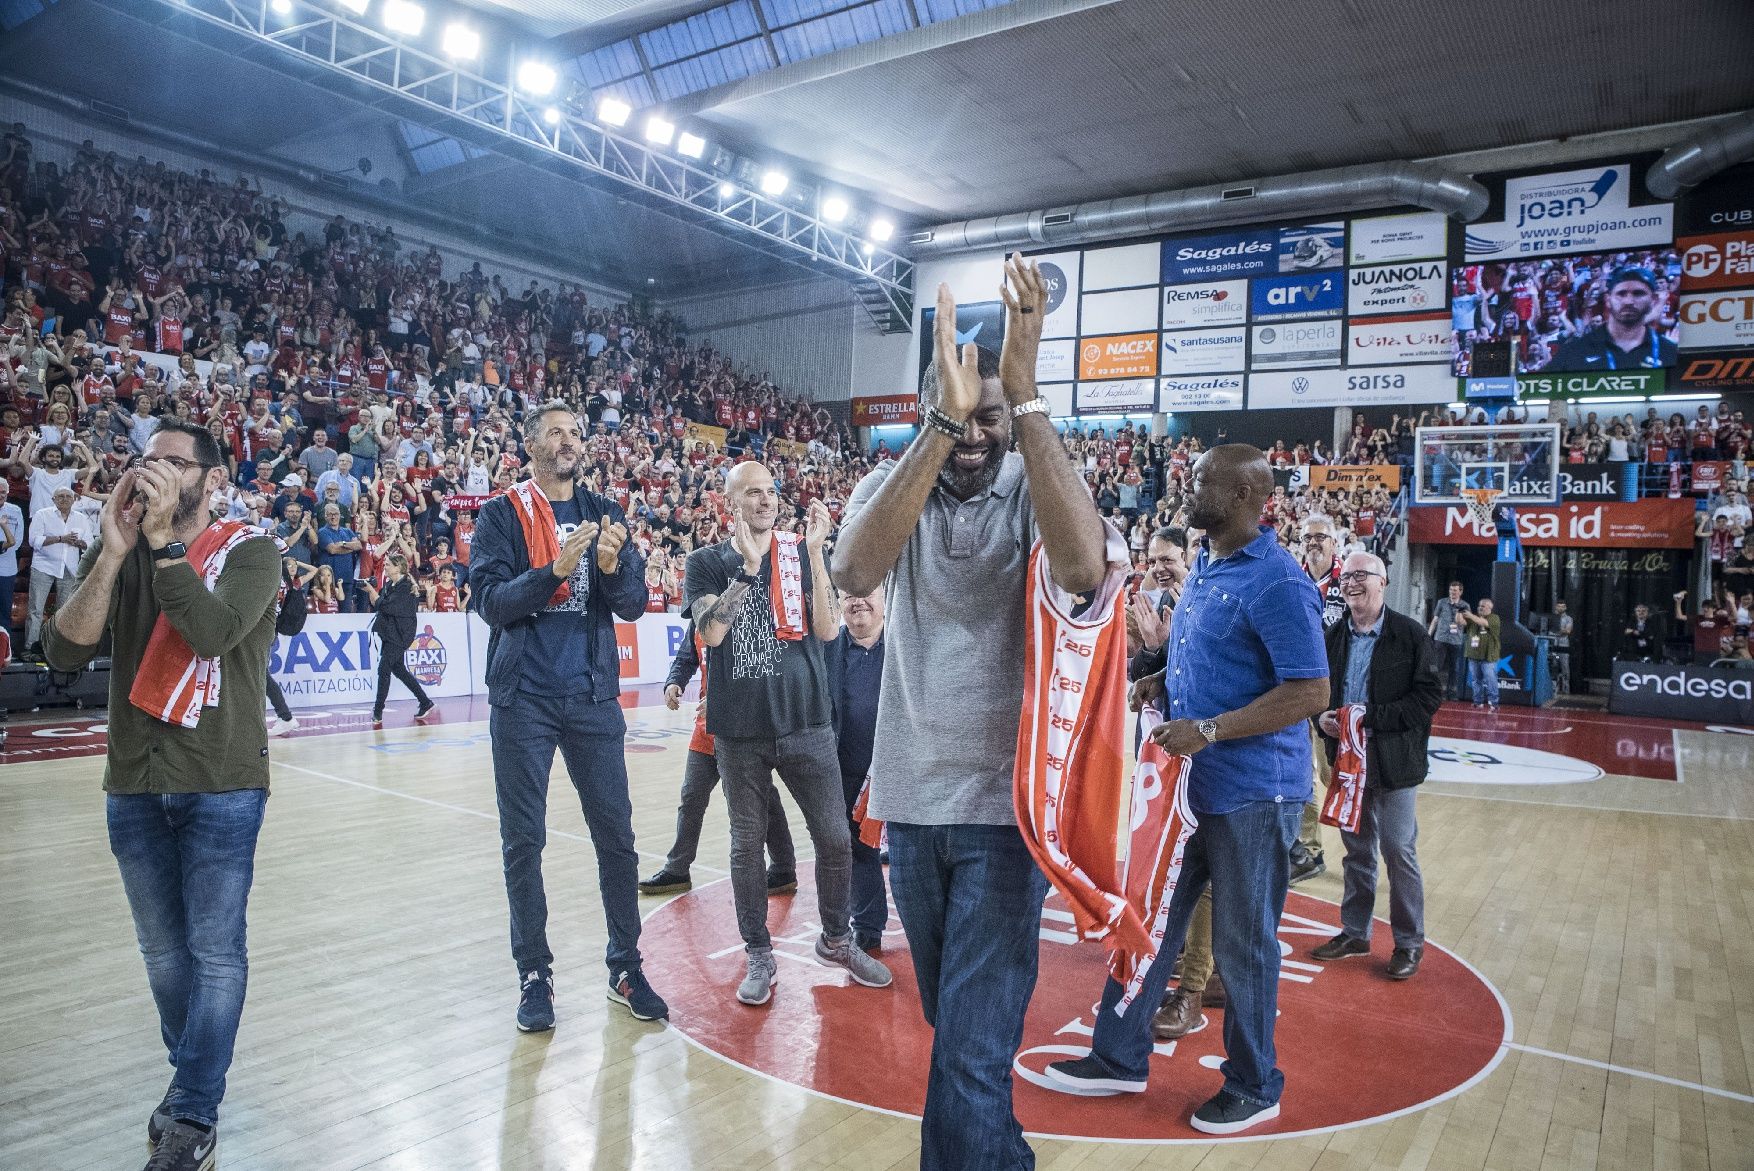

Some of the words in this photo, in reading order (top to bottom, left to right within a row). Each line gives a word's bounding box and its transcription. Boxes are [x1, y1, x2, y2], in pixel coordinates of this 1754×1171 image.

[1520, 186, 1586, 200] DISTRIBUIDORA
[1516, 196, 1586, 228] joan
[1520, 216, 1662, 239] www.grupjoan.com
[1176, 240, 1272, 260] Sagalés
[1182, 260, 1264, 274] www.sagales.com
[1686, 251, 1721, 271] PF
[1352, 265, 1442, 285] JUANOLA
[1192, 301, 1242, 316] simplifica
[1363, 296, 1406, 306] expert
[110, 313, 131, 322] BAXI
[1106, 340, 1155, 355] NACEX
[1181, 336, 1242, 346] santasusana
[1164, 379, 1239, 391] Sagalés
[1348, 374, 1405, 390] sarsa
[1557, 379, 1562, 391] i
[1568, 376, 1650, 391] CLARET
[869, 402, 915, 414] ESTRELLA
[1444, 508, 1560, 538] Masa
[1569, 505, 1602, 539] id
[1064, 639, 1092, 657] 25
[406, 649, 447, 665] BAXI
[280, 674, 373, 696] MATIZACIÓN
[1060, 677, 1081, 693] 25
[1620, 672, 1752, 700] endesa
[1051, 713, 1074, 732] 25
[1047, 830, 1057, 842] 5
